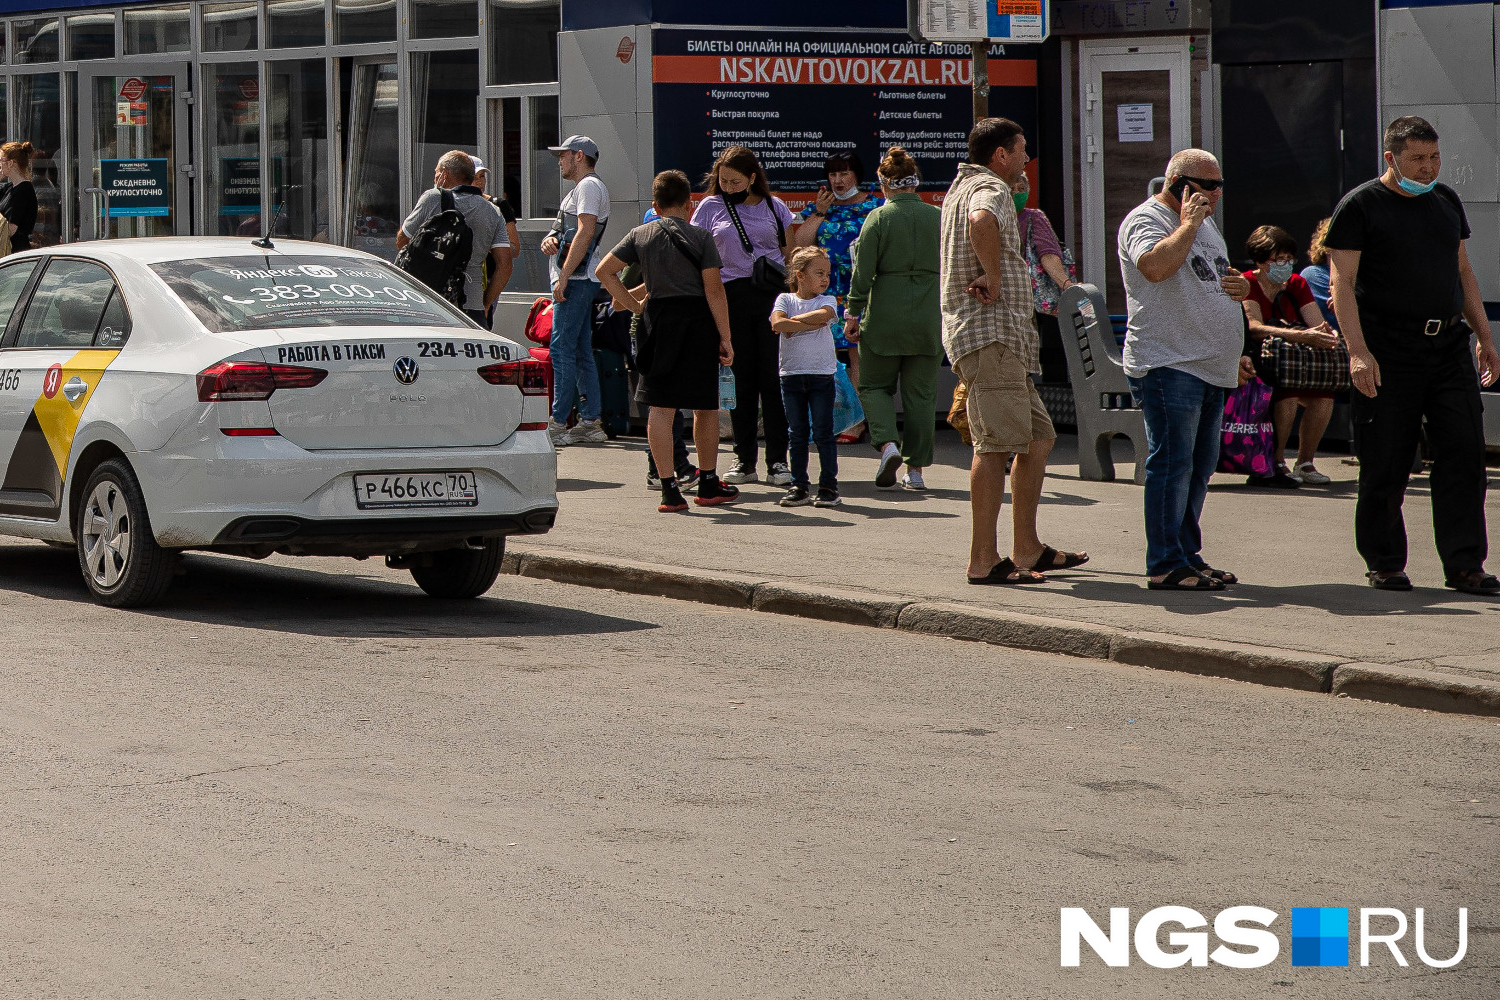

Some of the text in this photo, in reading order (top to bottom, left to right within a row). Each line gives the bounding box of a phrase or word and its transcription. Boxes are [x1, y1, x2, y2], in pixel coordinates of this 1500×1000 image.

[1078, 2, 1151, 29] TOILET
[687, 39, 1006, 55] БИЛЕТЫ ОНЛАЙН НА ОФИЦИАЛЬНОМ САЙТЕ АВТОВОЛА
[719, 57, 973, 85] NSKAVTOVOKZAL.RU
[711, 90, 770, 100] Круглосуточно
[879, 90, 947, 100] Льготные билеты
[712, 109, 780, 119] Быстрая покупка
[879, 111, 942, 120] Детские билеты
[712, 129, 766, 140] Электронный
[767, 129, 791, 138] билет
[803, 131, 823, 139] надо
[880, 130, 905, 139] Выбор
[907, 130, 942, 140] удобного
[776, 141, 821, 149] достаточно
[924, 140, 943, 150] рейс:
[762, 150, 800, 159] телефона
[113, 179, 157, 187] ЕЖЕДНЕВНО
[230, 268, 301, 280] Яндекс
[337, 268, 389, 280] Такси
[251, 284, 427, 304] 383-00-00
[278, 344, 386, 363] РАБОТА В ТАКСИ
[417, 342, 510, 361] 234-91-09
[47, 368, 58, 393] Я
[448, 475, 468, 491] 70
